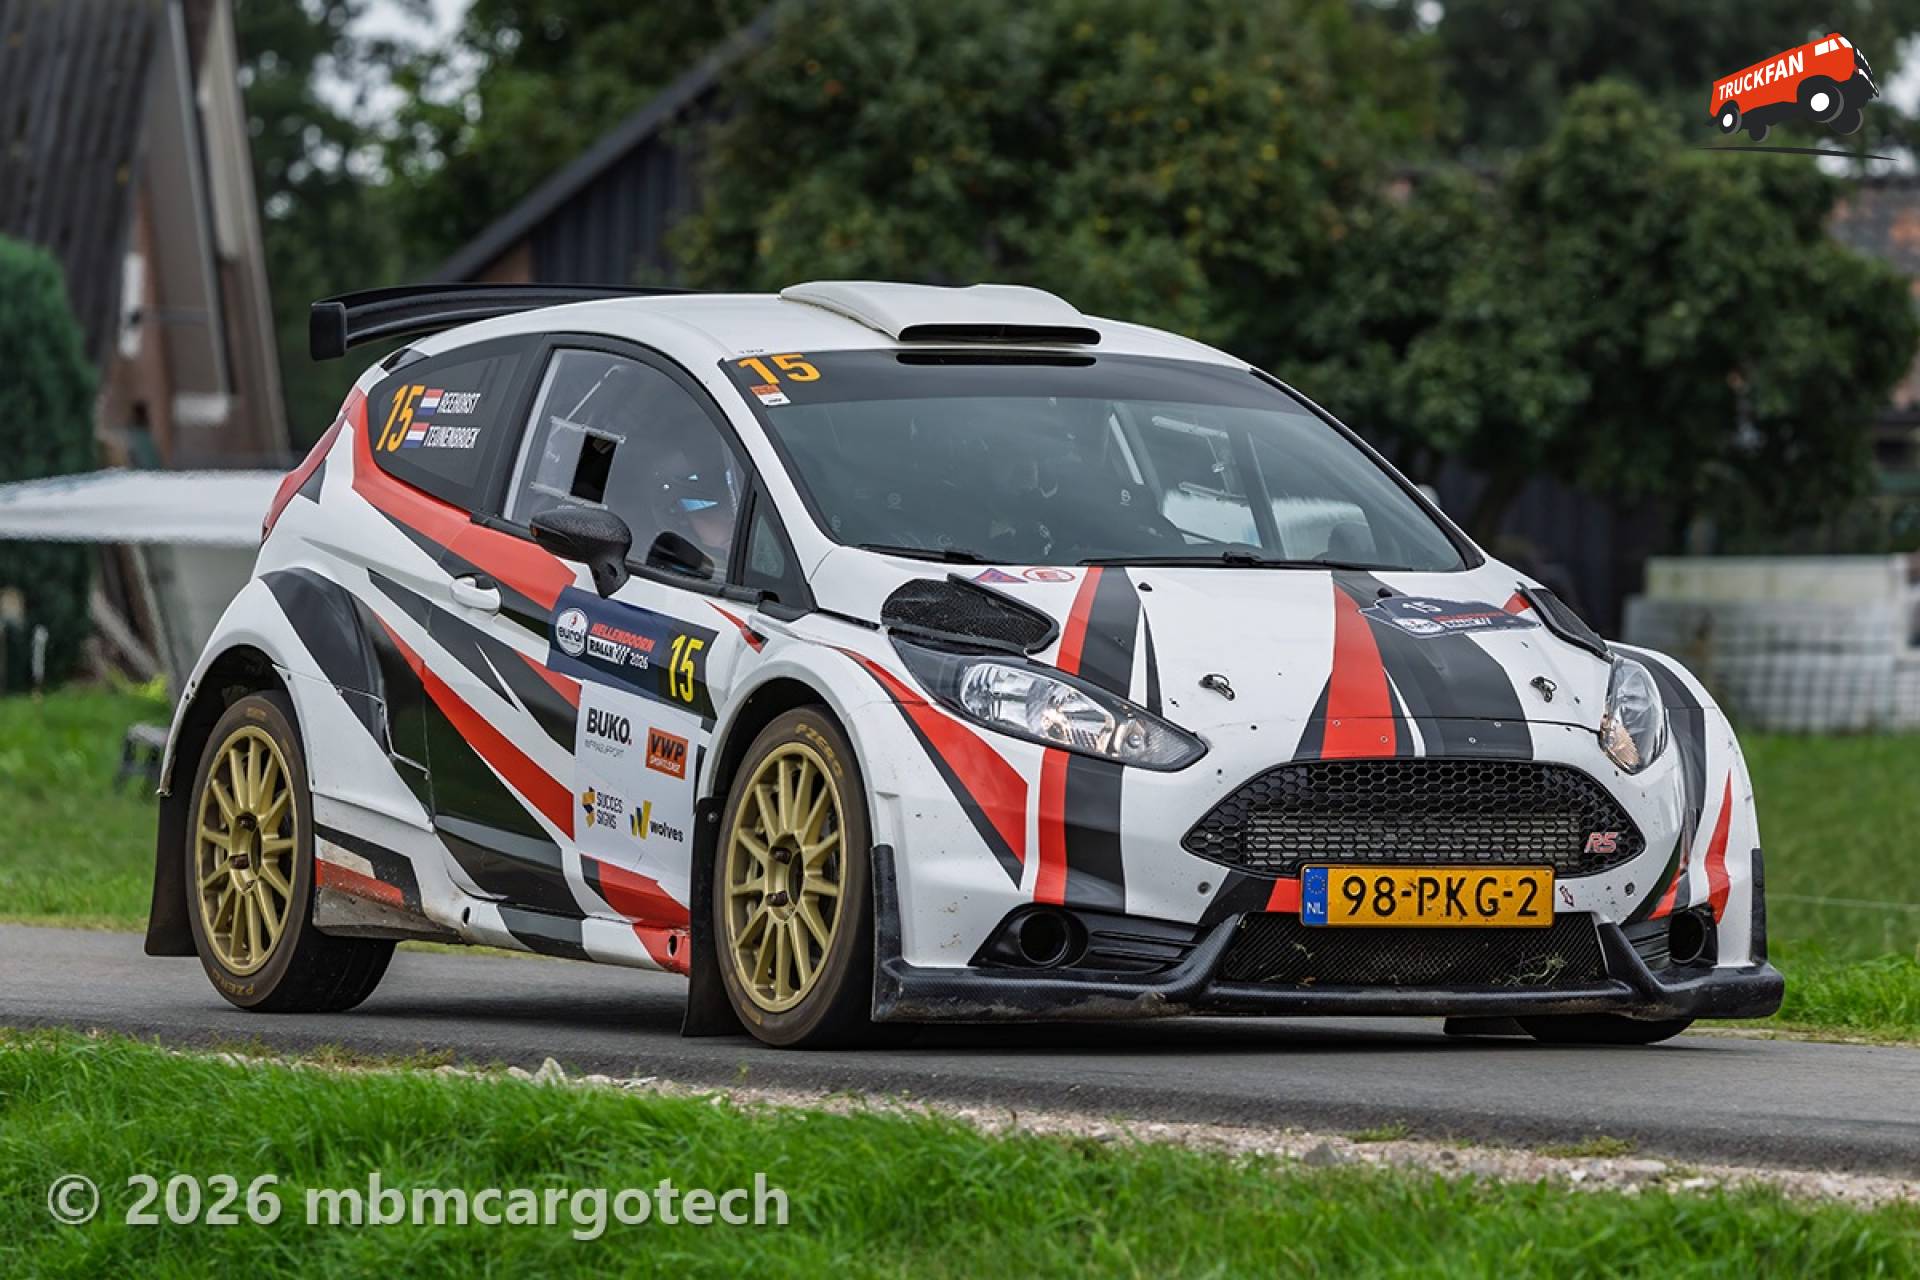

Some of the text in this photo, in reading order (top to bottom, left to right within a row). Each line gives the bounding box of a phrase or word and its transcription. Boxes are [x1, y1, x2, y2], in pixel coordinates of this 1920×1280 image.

[737, 353, 822, 385] 15
[375, 384, 426, 452] 15
[591, 623, 656, 653] HELLENDOORN
[669, 634, 704, 703] 15
[651, 733, 686, 761] VWP
[596, 791, 623, 813] SUCCES
[596, 809, 617, 829] SIGNS
[650, 819, 684, 842] wolves
[1583, 832, 1619, 853] RS
[1306, 902, 1325, 915] NL
[1342, 875, 1539, 917] 98-PKG-2
